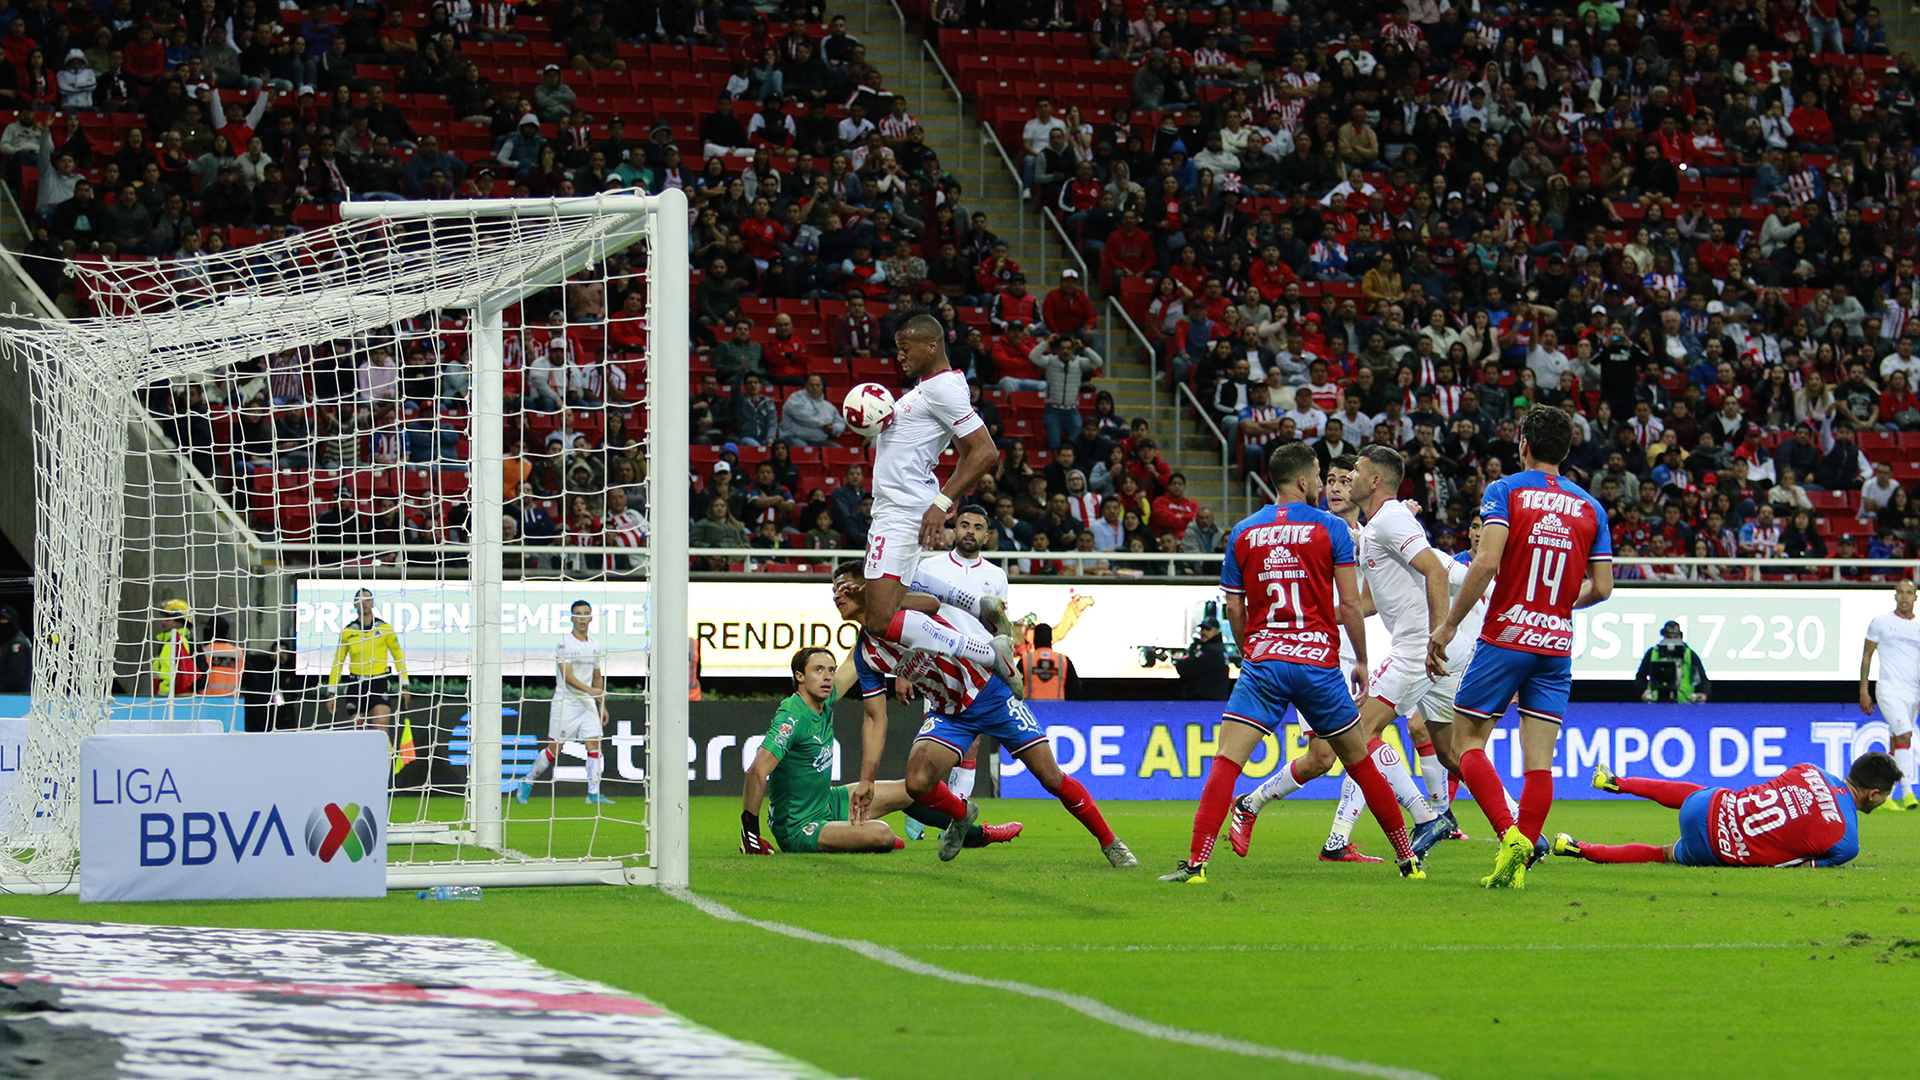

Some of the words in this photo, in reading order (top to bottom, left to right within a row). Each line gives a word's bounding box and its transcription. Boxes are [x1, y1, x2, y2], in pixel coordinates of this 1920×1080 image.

[1518, 490, 1586, 518] TECATE
[1245, 525, 1315, 549] TECATE
[1532, 522, 1570, 535] granvita
[1538, 536, 1572, 550] BRISEÑO
[1258, 571, 1283, 581] HIRAM
[1263, 556, 1299, 570] granvita
[1526, 547, 1567, 606] 14
[1266, 582, 1304, 629] 21
[1497, 604, 1573, 632] AKRON
[1268, 641, 1330, 661] telcel
[1518, 629, 1573, 651] telcel
[1009, 706, 1037, 731] 30
[1046, 725, 1126, 777] DE
[1709, 727, 1787, 777] DE
[93, 768, 182, 804] LIGA
[1801, 769, 1842, 823] TECATE
[1737, 789, 1787, 837] 20
[140, 803, 295, 866] BBVA
